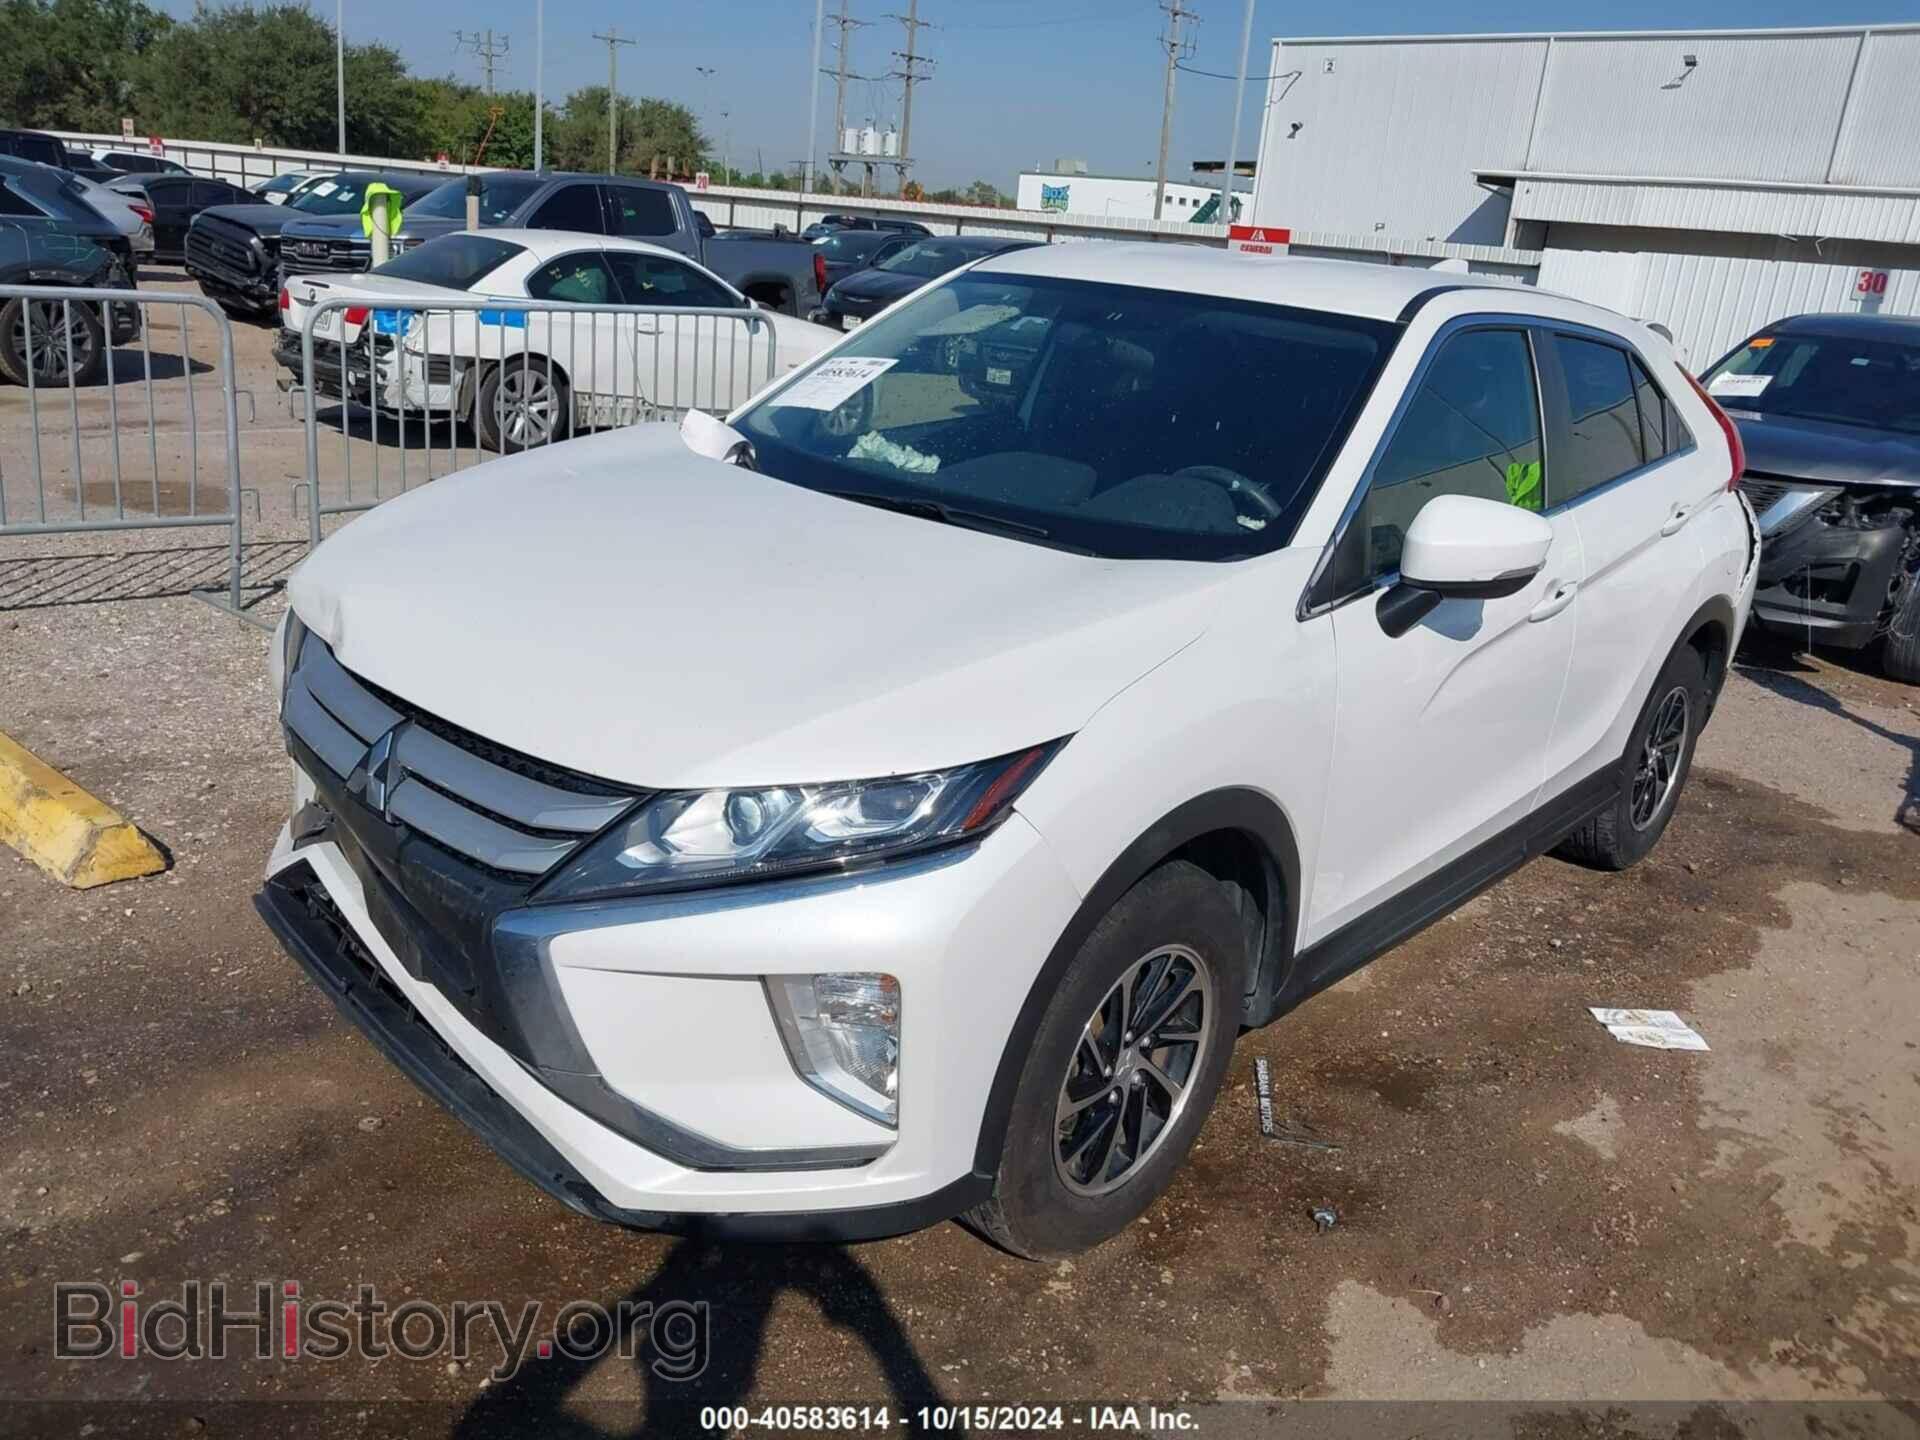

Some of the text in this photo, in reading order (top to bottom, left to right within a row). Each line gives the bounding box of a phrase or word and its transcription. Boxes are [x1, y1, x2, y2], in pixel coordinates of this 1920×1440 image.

[697, 175, 708, 189] 20
[1858, 271, 1888, 294] 30
[1260, 1097, 1273, 1133] MOTORS
